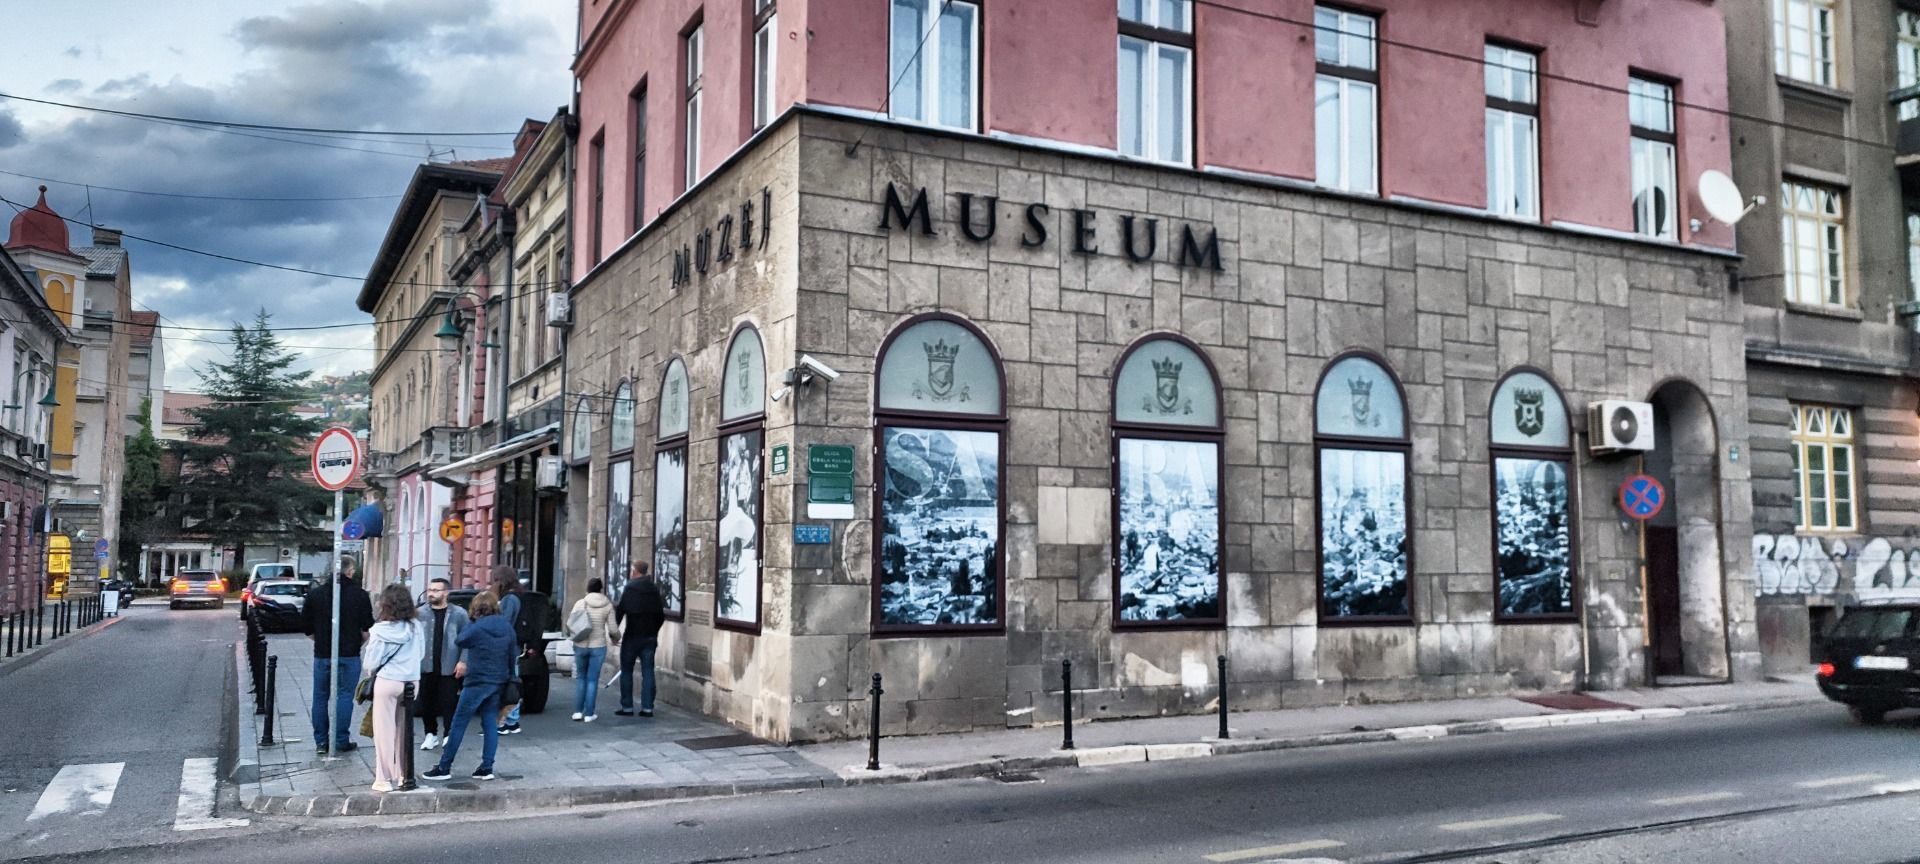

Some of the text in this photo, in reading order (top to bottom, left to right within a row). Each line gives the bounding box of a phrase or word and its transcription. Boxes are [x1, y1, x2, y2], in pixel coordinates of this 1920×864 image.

[670, 185, 771, 290] MUZEJ
[877, 181, 1225, 272] MUSEUM
[884, 431, 992, 501] SA
